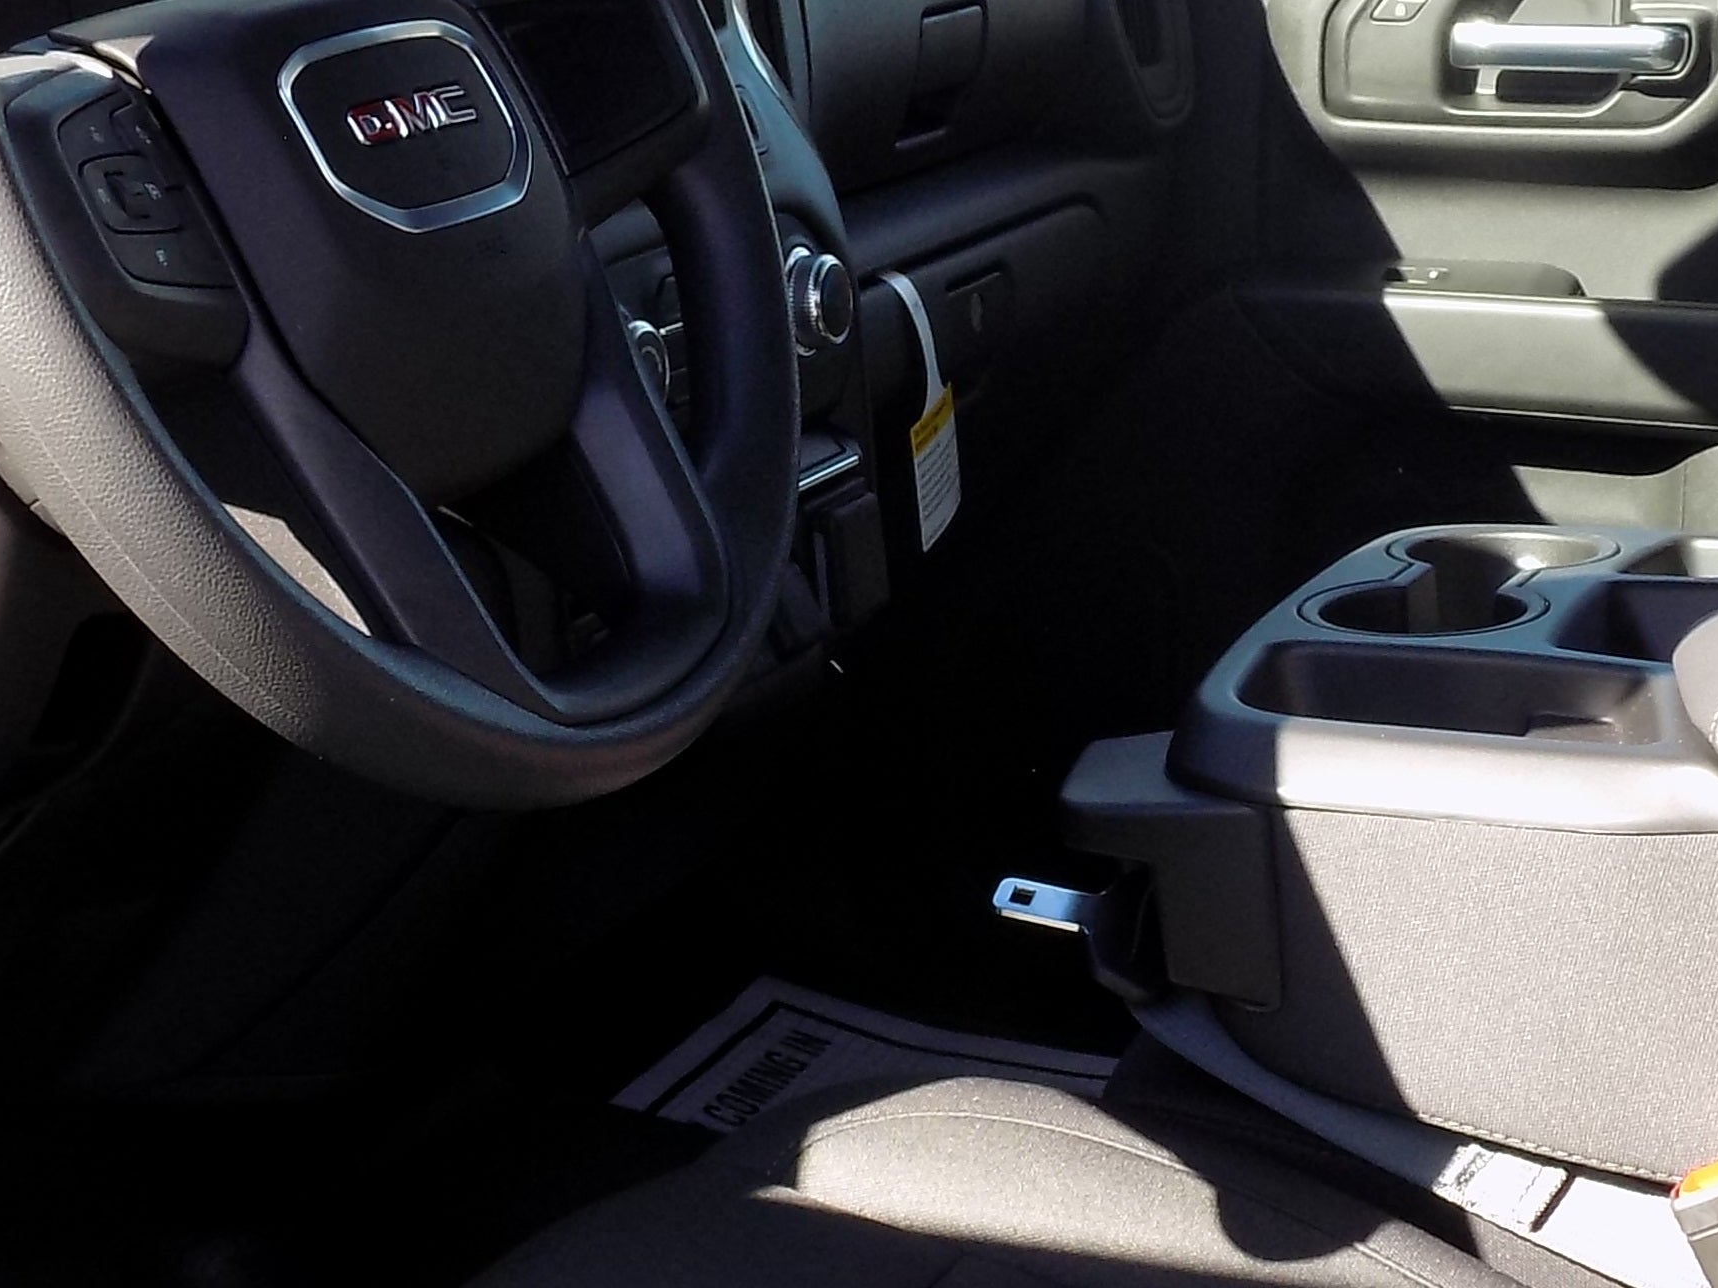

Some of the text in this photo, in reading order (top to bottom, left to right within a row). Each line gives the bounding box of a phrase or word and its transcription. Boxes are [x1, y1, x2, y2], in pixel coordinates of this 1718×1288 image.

[346, 85, 478, 145] GMC
[703, 1029, 832, 1127] COMING IN
